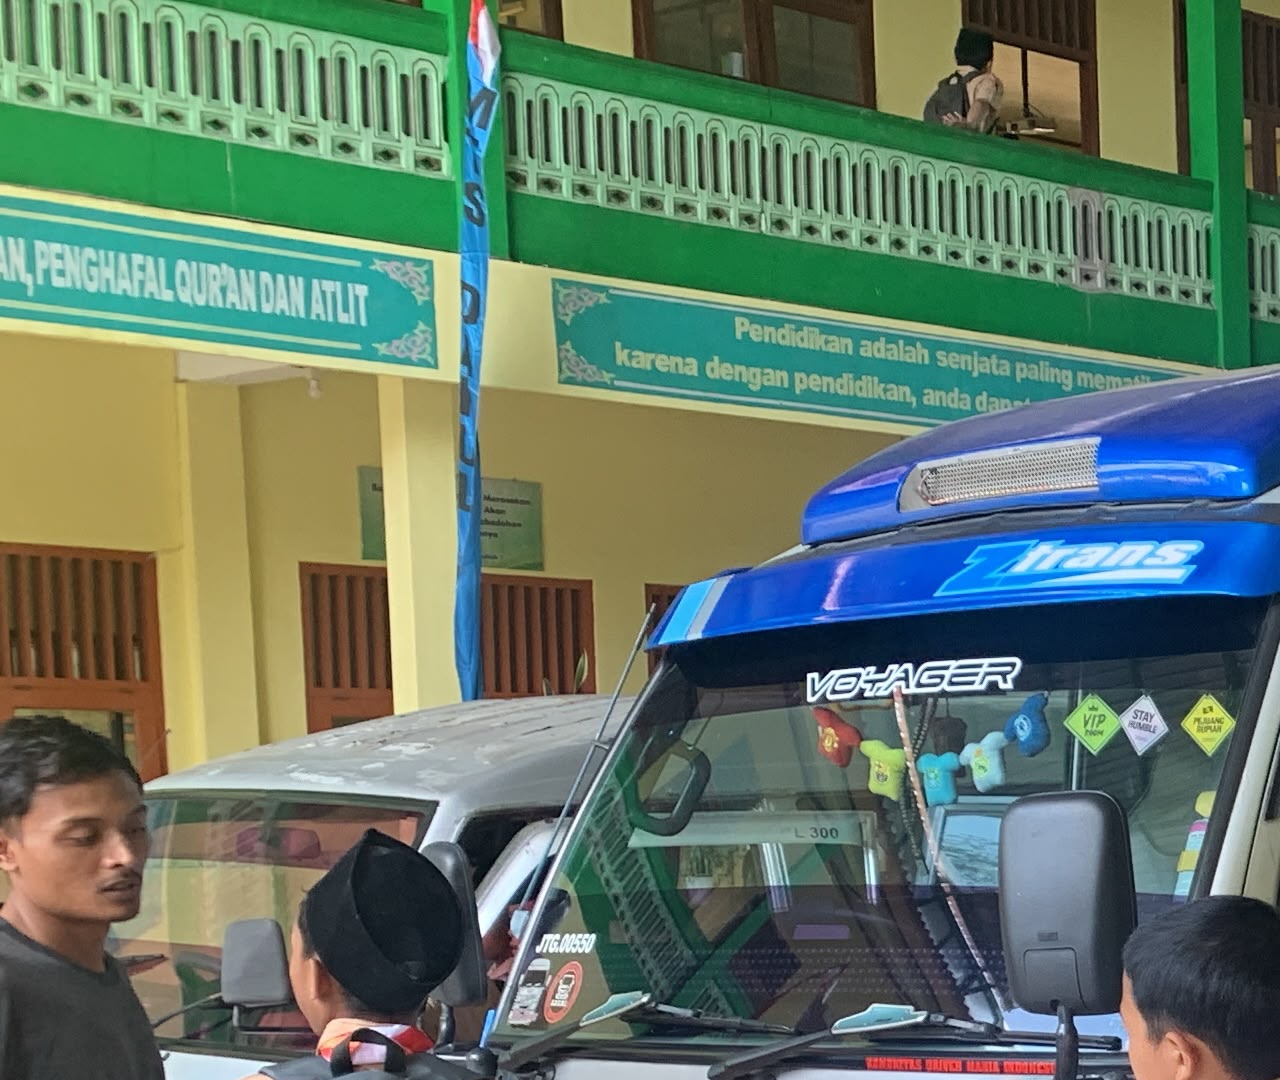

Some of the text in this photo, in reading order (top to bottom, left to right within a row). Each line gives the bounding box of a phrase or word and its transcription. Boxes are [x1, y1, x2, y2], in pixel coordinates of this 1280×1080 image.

[34, 239, 174, 302] PENGHAFAL
[259, 271, 305, 319] DAN
[310, 275, 369, 327] ATLIT
[734, 316, 854, 356] Pendidikan
[859, 337, 930, 364] adalah
[936, 349, 1011, 378] senjata
[1015, 360, 1073, 392] paling
[614, 341, 699, 377] karena
[705, 356, 789, 392] dengan
[793, 370, 917, 408] pendidikan,
[922, 387, 971, 411] anda
[806, 656, 1022, 702] VOYAGER
[1083, 713, 1106, 729] VIP
[1128, 721, 1158, 734] HUMBLE
[1132, 709, 1155, 723] STAY
[535, 933, 597, 954] JTG.00550
